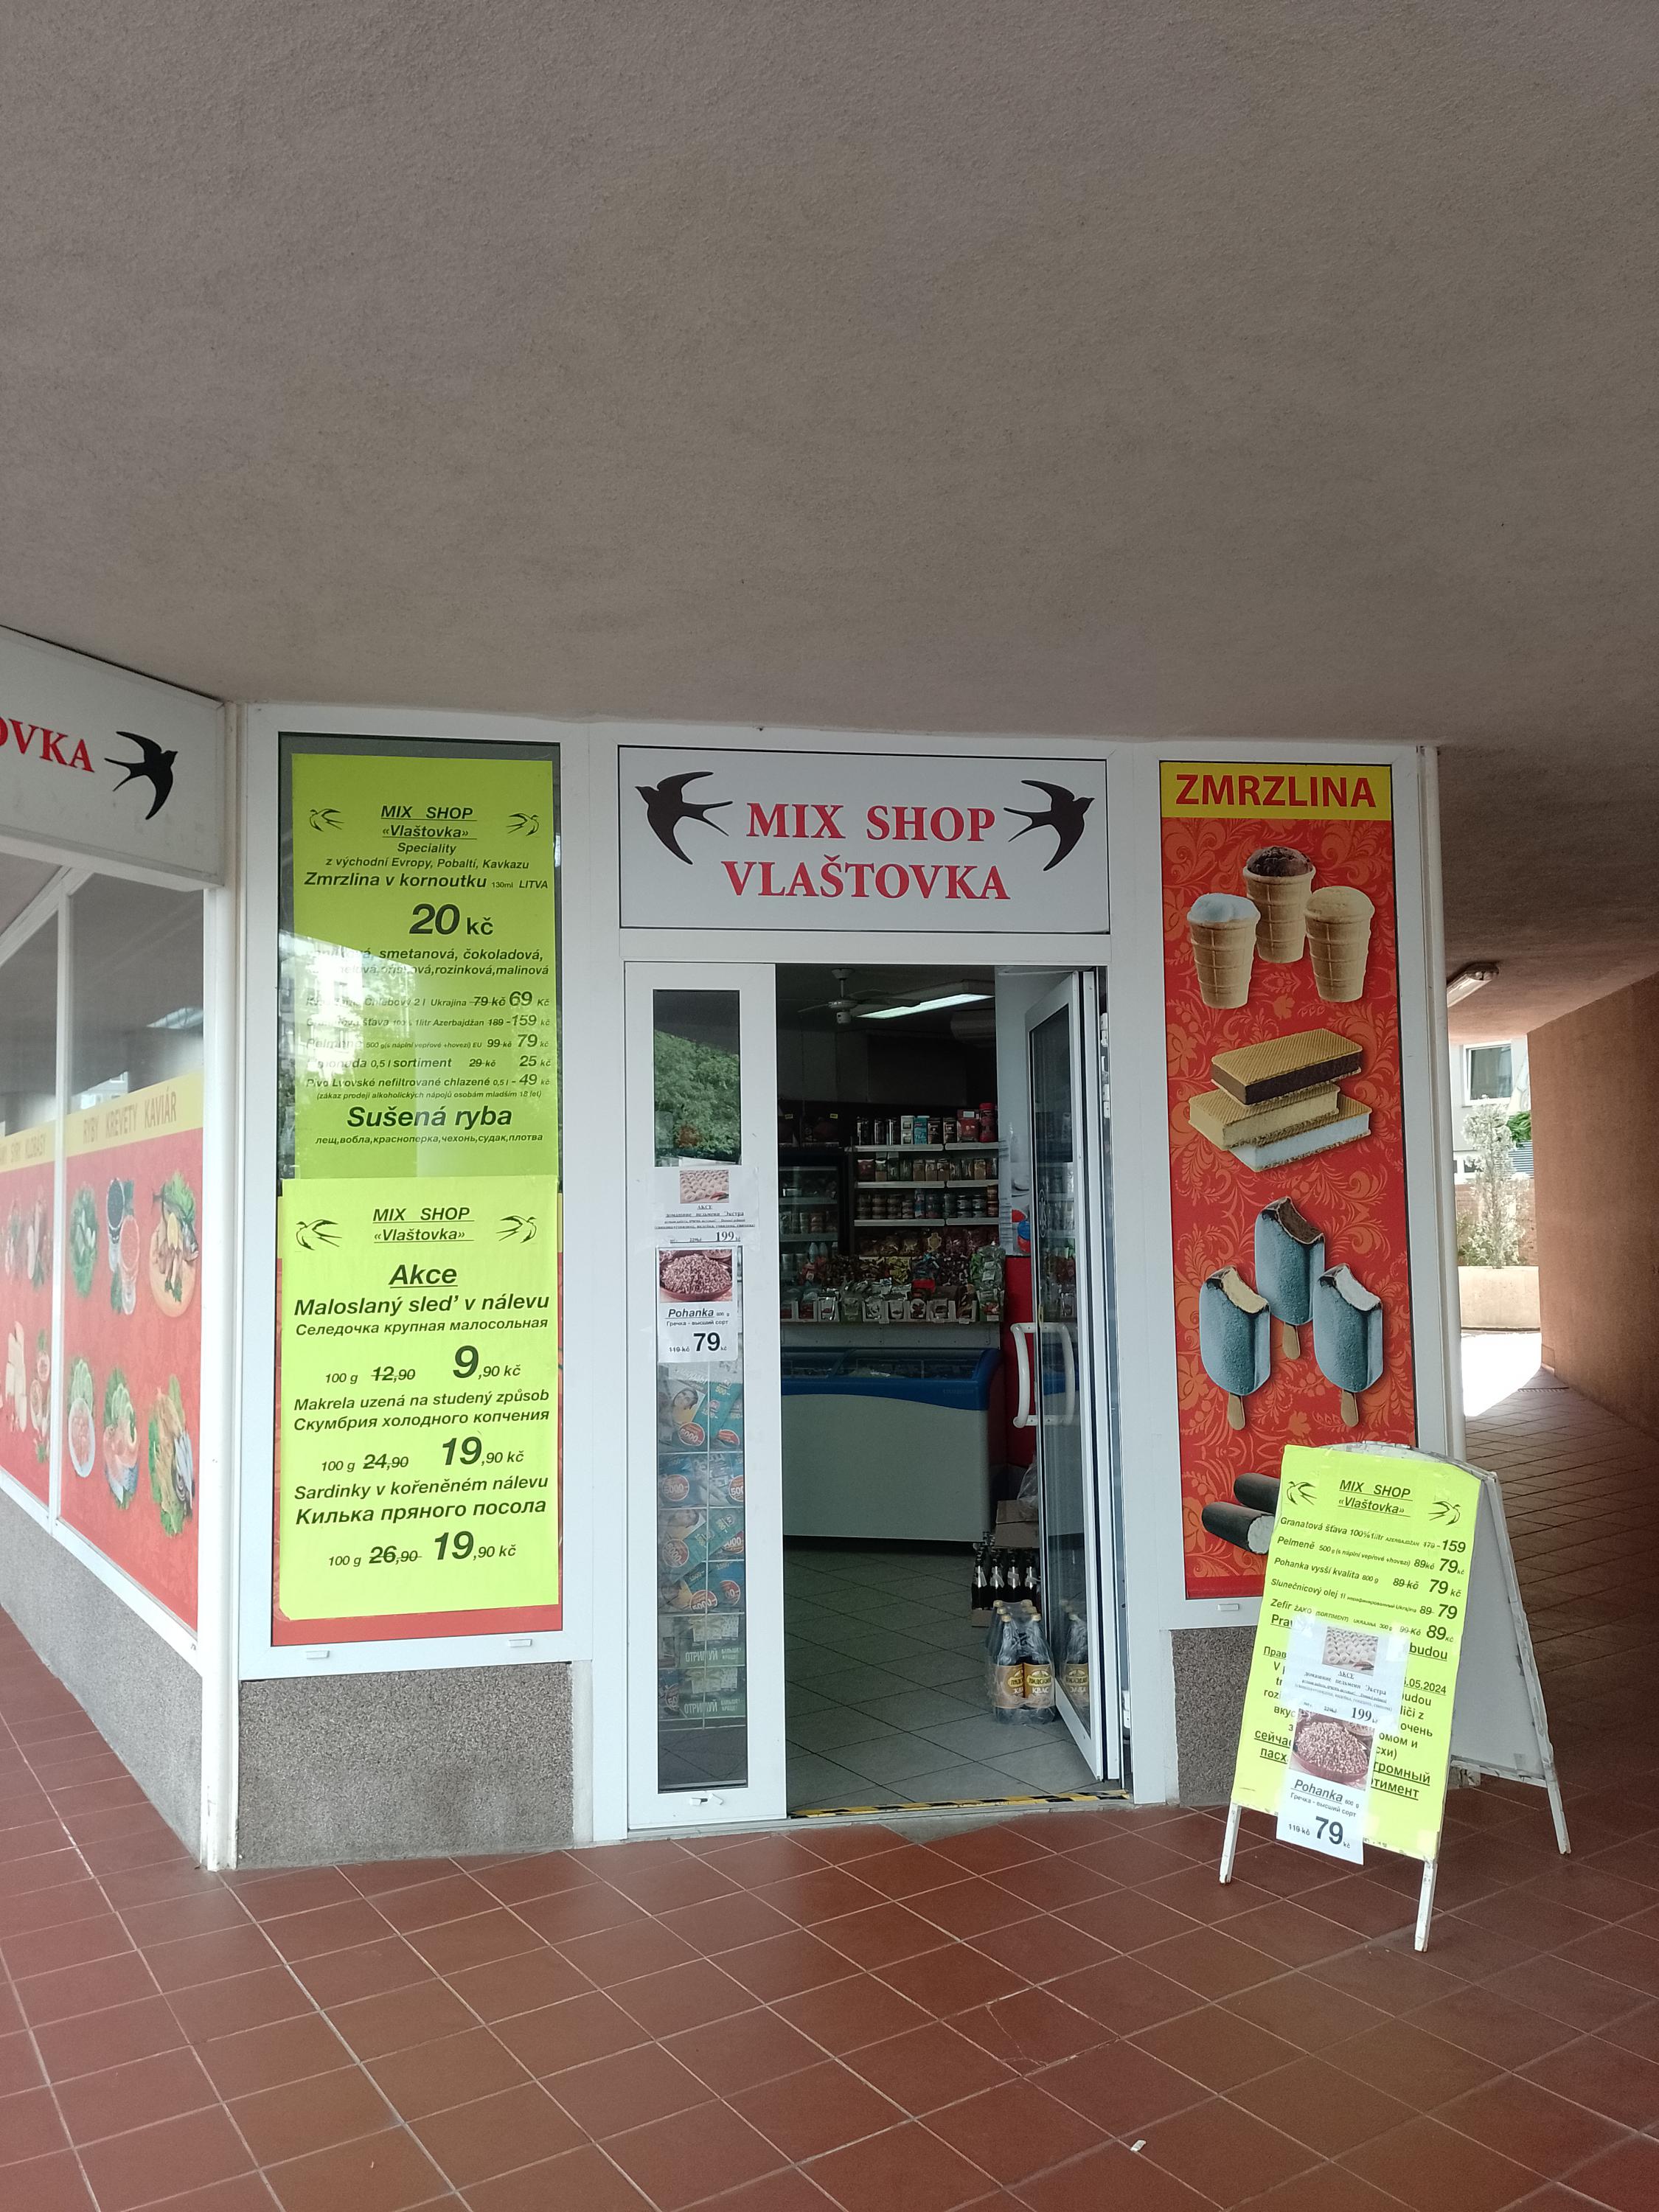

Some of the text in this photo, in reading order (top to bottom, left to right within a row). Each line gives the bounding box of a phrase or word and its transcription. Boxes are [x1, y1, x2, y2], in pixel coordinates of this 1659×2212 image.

[0, 717, 94, 773] VKA
[1176, 774, 1376, 807] ZMRZLINA
[381, 805, 473, 820] MIX SHOP
[746, 801, 995, 842] MIX SHOP
[397, 843, 456, 855] Speciality
[335, 858, 389, 867] východní
[392, 858, 434, 869] Evropy,
[437, 859, 479, 869] Pobaltí,
[482, 860, 529, 869] Kavkazu
[304, 872, 379, 886] Zmrzlina
[385, 876, 394, 886] v
[400, 873, 487, 888] kornoutku
[519, 880, 548, 889] LITVA
[722, 855, 1010, 900] VLAŠTOVKA
[409, 903, 493, 935] 20 kč
[380, 950, 457, 961] smetanová,
[464, 948, 543, 961] čokoladová,
[431, 999, 466, 1007] Ukrajina
[492, 997, 506, 1006] kč
[509, 991, 532, 1006] 69
[433, 1019, 484, 1027] Azerbajdžan
[487, 1039, 500, 1048] 99
[518, 1034, 538, 1048] 79
[371, 1060, 385, 1068] 0,5
[394, 1058, 451, 1068] sortiment
[469, 1059, 482, 1067] 29
[519, 1055, 537, 1066] 25
[378, 1078, 441, 1087] nefiltrované
[444, 1077, 490, 1085] chlazené
[519, 1074, 537, 1085] 49
[145, 1087, 176, 1127] KAVIÁR
[347, 1106, 512, 1130] Sušená ryba
[373, 1207, 470, 1221] MIX SHOP
[717, 1231, 734, 1242] 199
[389, 1264, 457, 1285] Akce
[294, 1294, 549, 1316] Maloslaný v nálevu
[668, 1308, 714, 1318] Pohanka
[296, 1318, 548, 1336] Селедочка крупная малосольная
[694, 1332, 720, 1352] 79
[325, 1373, 347, 1383] 100
[349, 1374, 358, 1385] g
[504, 1365, 521, 1376] kč
[294, 1388, 549, 1410] Makrela uzená na studený způsob
[294, 1410, 549, 1432] Скумбрия холодного копчения
[321, 1461, 343, 1471] 100
[347, 1462, 355, 1472] g
[507, 1451, 524, 1463] kč
[295, 1476, 548, 1500] Sardinky v kořeněném nálevu
[1340, 1480, 1411, 1498] MIX SHOP
[296, 1500, 546, 1525] Килька пряного посола
[1280, 1517, 1347, 1534] Granatová šťava
[329, 1556, 349, 1566] 100
[353, 1557, 361, 1567] g
[499, 1544, 515, 1557] kč
[1277, 1536, 1315, 1549] Pelmeně
[1439, 1558, 1458, 1573] 79
[1274, 1557, 1309, 1570] Pohanka
[1332, 1568, 1360, 1579] kvalita
[1393, 1578, 1405, 1587] 89
[1429, 1579, 1448, 1594] 79
[1450, 1588, 1461, 1597] kč
[1271, 1579, 1321, 1596] Slunečnicový
[1324, 1589, 1338, 1599] olej
[1438, 1604, 1457, 1619] 79
[1426, 1625, 1447, 1640] 89
[1352, 1708, 1371, 1721] 199
[1400, 1723, 1433, 1736] очень
[1411, 1740, 1418, 1748] и
[1294, 1779, 1343, 1802] Pohanka
[1290, 1792, 1311, 1804] Гречка
[1317, 1802, 1340, 1812] высший
[1316, 1816, 1343, 1844] 79
